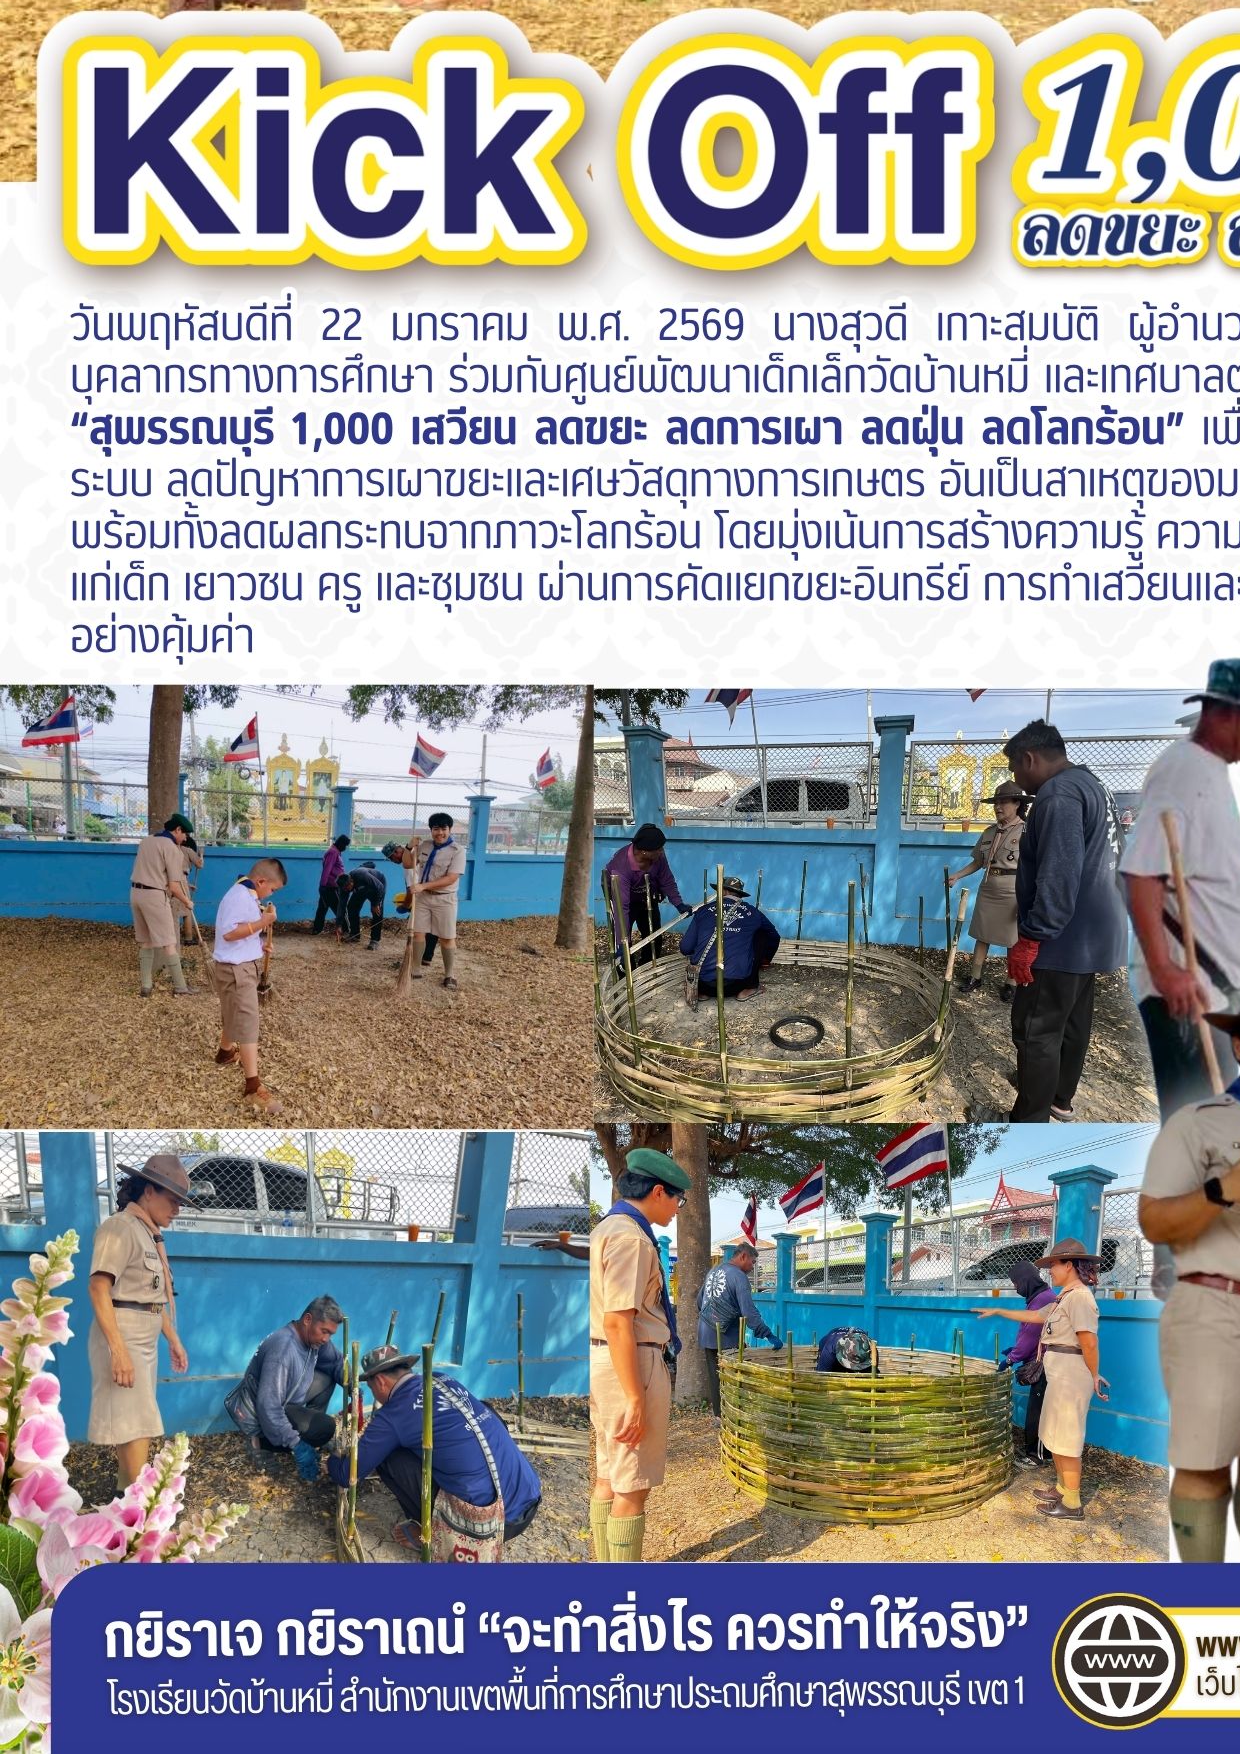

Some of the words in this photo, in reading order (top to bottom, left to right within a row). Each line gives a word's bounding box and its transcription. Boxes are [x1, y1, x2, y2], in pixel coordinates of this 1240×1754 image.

[94, 67, 556, 240] Kick
[648, 64, 964, 240] Off
[1022, 210, 1200, 256] ลดขยะ
[70, 292, 292, 351] วันพฤหัสบดีที่
[322, 307, 362, 341] 22
[392, 312, 528, 341] มกราคม
[558, 309, 630, 341] พ.ศ.
[659, 307, 744, 341] 2569
[774, 302, 907, 354] นางสุวดี
[937, 302, 1098, 354] เกาะสมบัติ
[72, 352, 433, 406] บุคลากรทางการศึกษา
[449, 351, 1028, 406] ร่วมกับศูนย์พัฒนาเด็กเล็กวัดบ้านหมี่
[71, 405, 274, 458] “สุพรรณบุรี
[291, 411, 393, 453] 1,000
[412, 405, 516, 445] เสวียน
[535, 416, 647, 445] ลดขยะ
[665, 416, 842, 445] ลดการเผา
[861, 403, 963, 458] ลดฝุ่น
[982, 404, 1184, 445] ลดโลกร้อน”
[70, 468, 152, 497] ระบบ
[167, 457, 925, 510] ลดปัญหาการเผาขยะและเศษวัสดุทางการเกษตร
[72, 501, 701, 549] พร้อมทั้งลดผลกระทบจากภาวะโลกร้อน
[713, 508, 1146, 562] โดยมุ่งเน้นการสร้างความรู้
[72, 559, 169, 601] แก่เด็ก
[185, 572, 303, 601] เยาวชน
[318, 572, 362, 614] ครู
[377, 572, 523, 614] และชุมชน
[538, 559, 971, 601] ผ่านการคัดแยกขยะอินทรีย์
[70, 611, 255, 666] อย่างคุ้มค่า
[104, 1610, 263, 1658] กยิราเจ
[479, 1591, 713, 1653] “จะทำสิ่งไร
[727, 1594, 1028, 1651] ควรทำให้จริง”
[1083, 1652, 1157, 1670] www
[106, 1667, 334, 1715] โรงเรียนวัดบ้านหมี่
[340, 1666, 961, 1717] สำนักงานเขตพื้นที่การศึกษาประถมศึกษาสุพรรณบุรี
[968, 1679, 1008, 1705] เขต
[1014, 1676, 1024, 1704] 1
